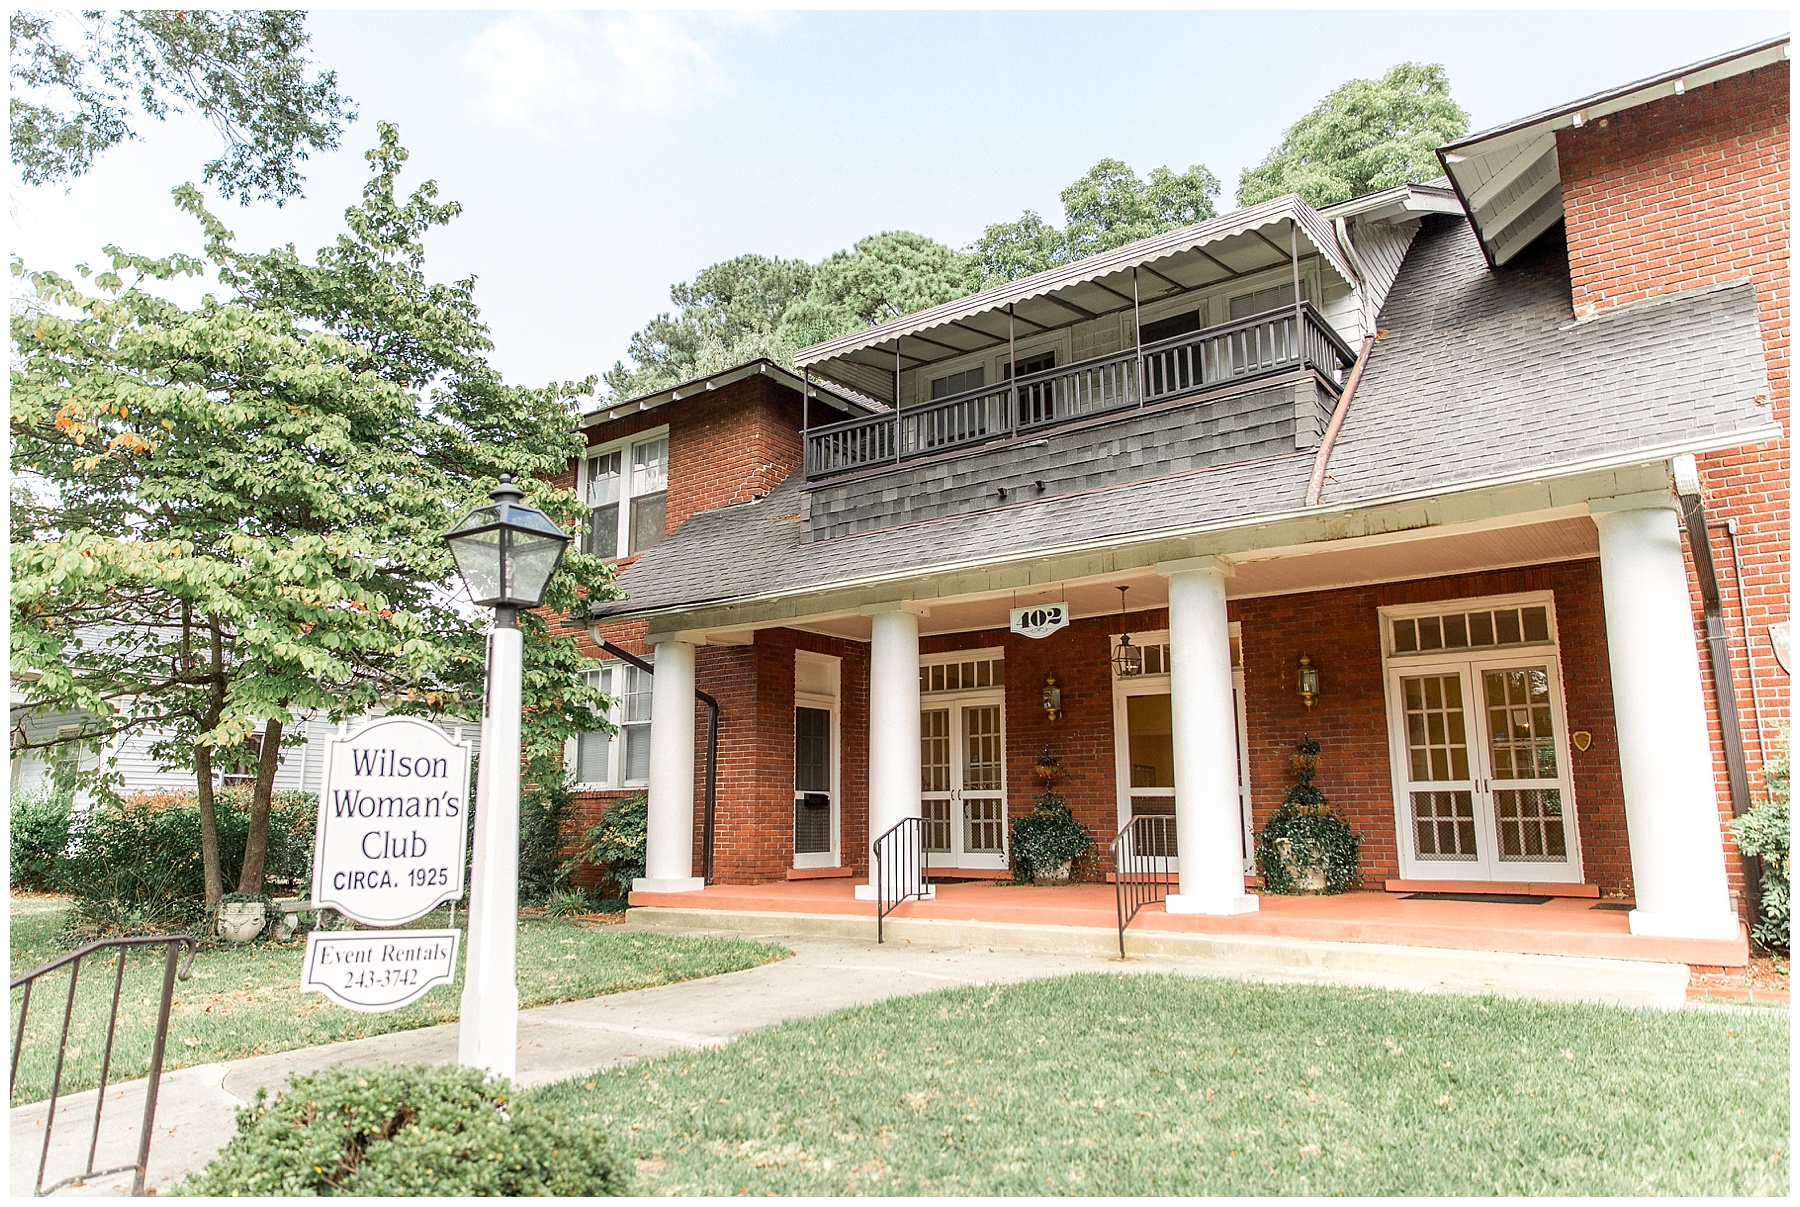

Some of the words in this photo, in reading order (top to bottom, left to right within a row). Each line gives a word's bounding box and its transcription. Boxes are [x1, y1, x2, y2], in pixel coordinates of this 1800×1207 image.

[1016, 607, 1062, 628] 402
[352, 748, 448, 779] Wilson
[333, 789, 459, 819] Woman's
[361, 829, 427, 860] Club
[333, 869, 398, 892] CIRCA.
[407, 867, 449, 888] 1925
[320, 946, 373, 965] Event
[381, 943, 447, 962] Rentals
[344, 968, 418, 989] 243-3742
